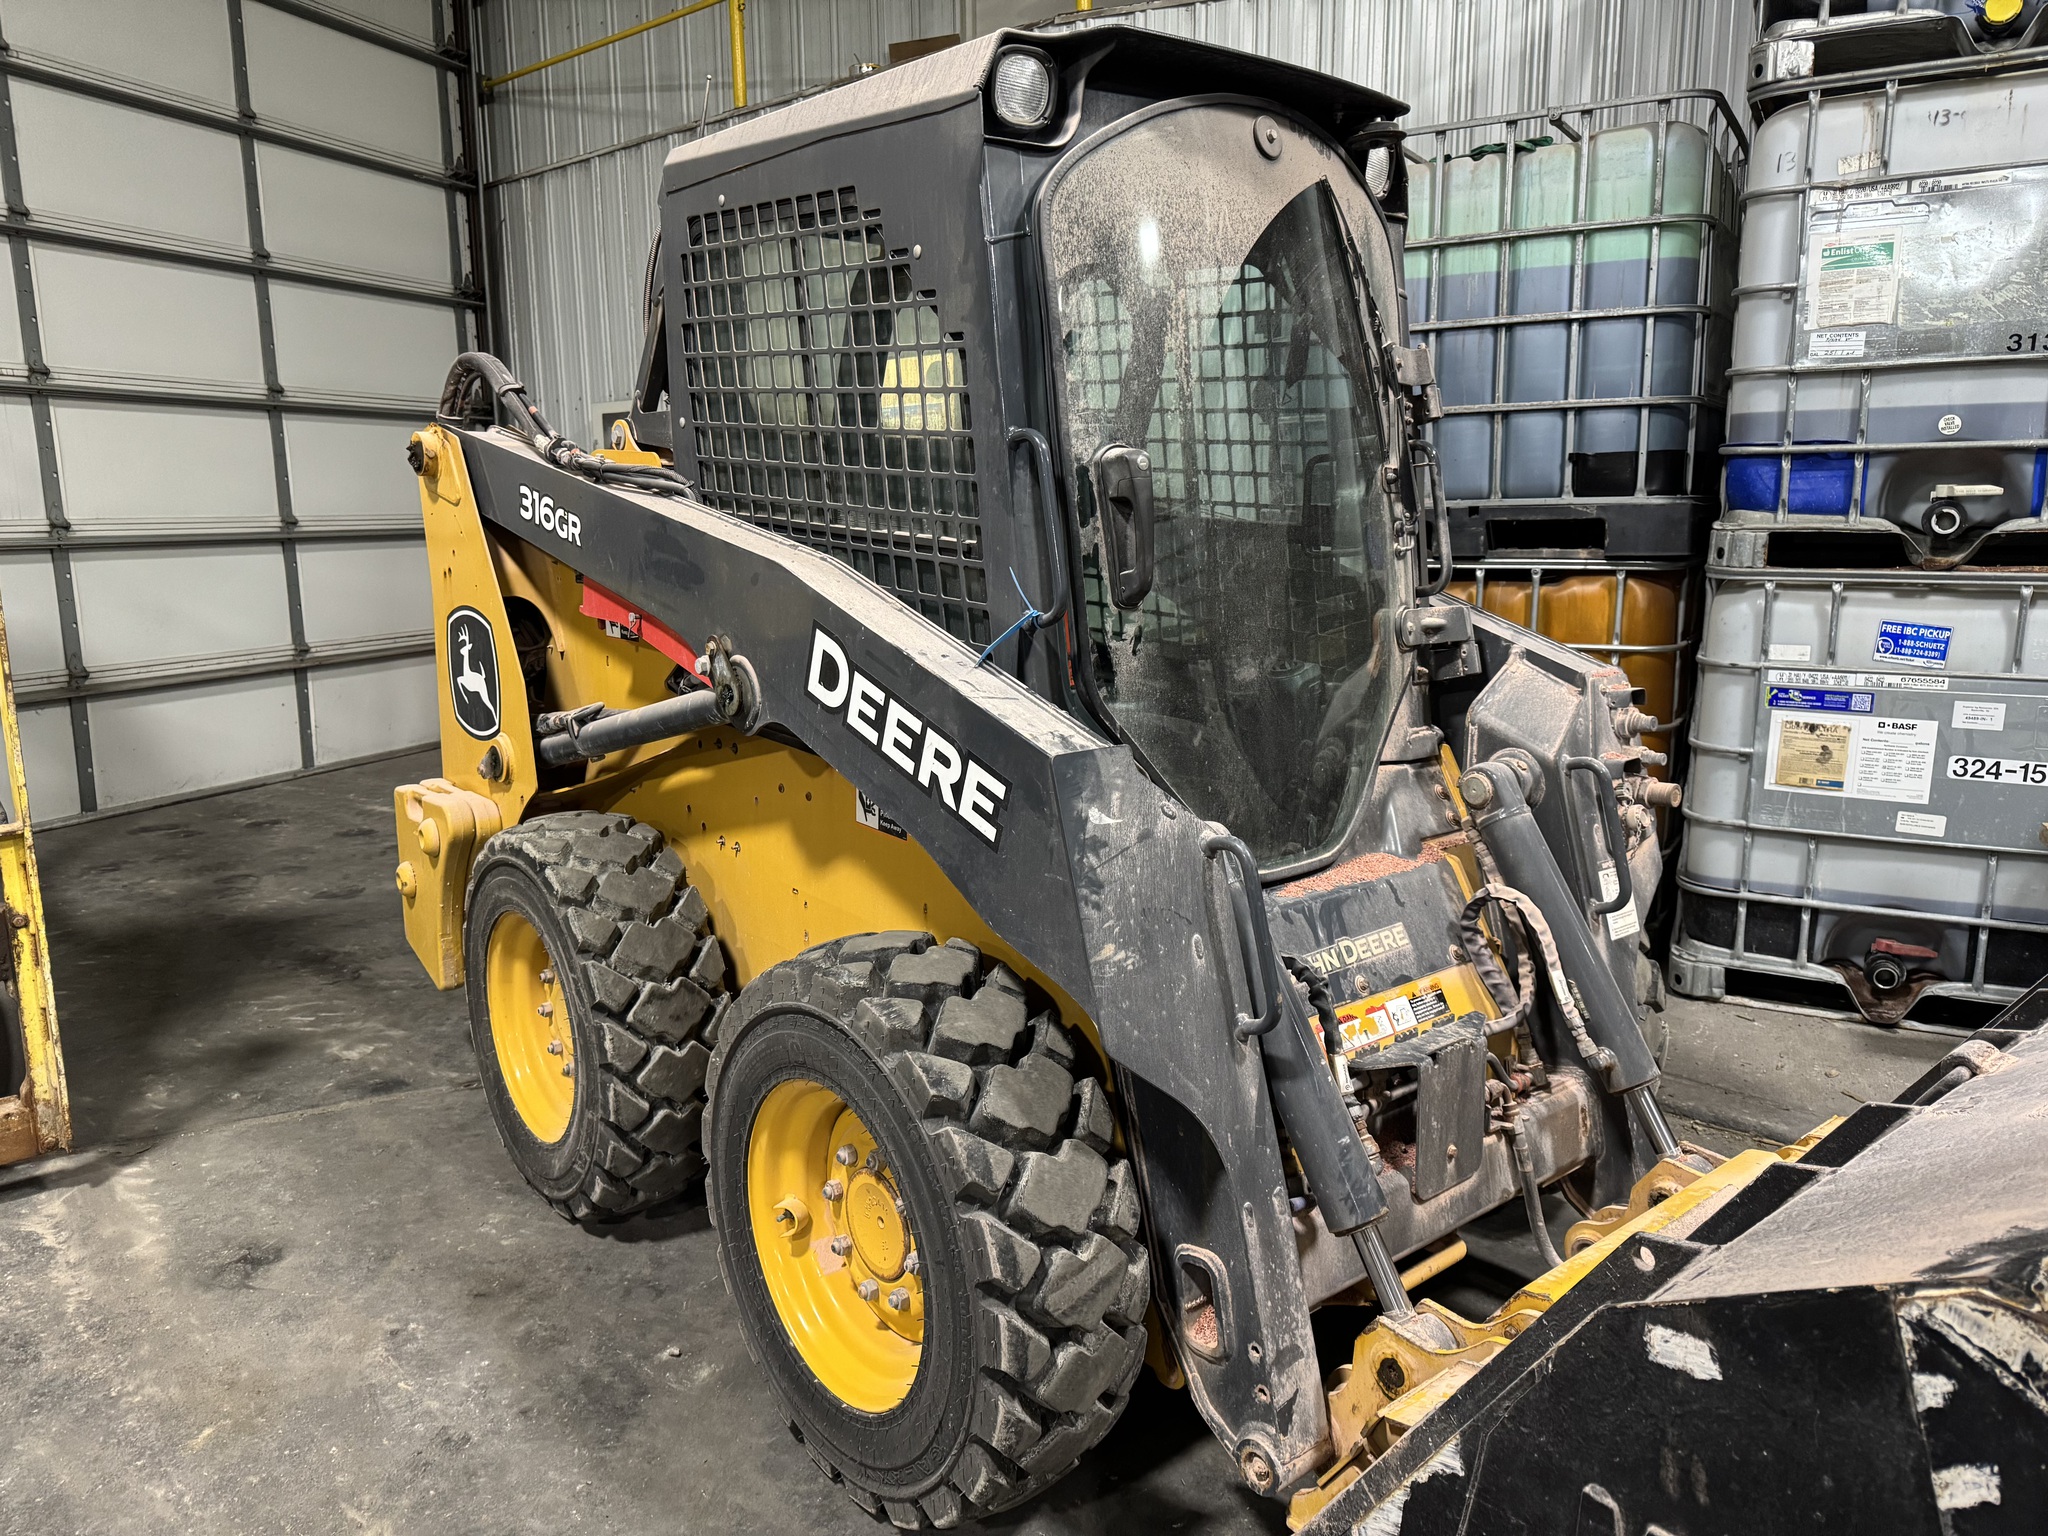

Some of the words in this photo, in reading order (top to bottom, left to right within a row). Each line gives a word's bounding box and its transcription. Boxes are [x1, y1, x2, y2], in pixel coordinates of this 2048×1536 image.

[1830, 247, 1854, 256] Enlist
[519, 485, 582, 547] 316GR
[1881, 623, 1903, 634] FREE
[1903, 625, 1918, 636] IBC
[1918, 627, 1951, 639] PICKUP
[1898, 638, 1946, 651] 1-888-SCHUETZ
[1893, 647, 1941, 659] (1-888-724-8389)
[1891, 722, 1918, 730] BASF
[807, 628, 1007, 843] DEERE
[1952, 757, 2047, 784] 324-15
[880, 820, 891, 830] Keep
[890, 823, 902, 834] Away
[1337, 925, 1411, 966] DEERE
